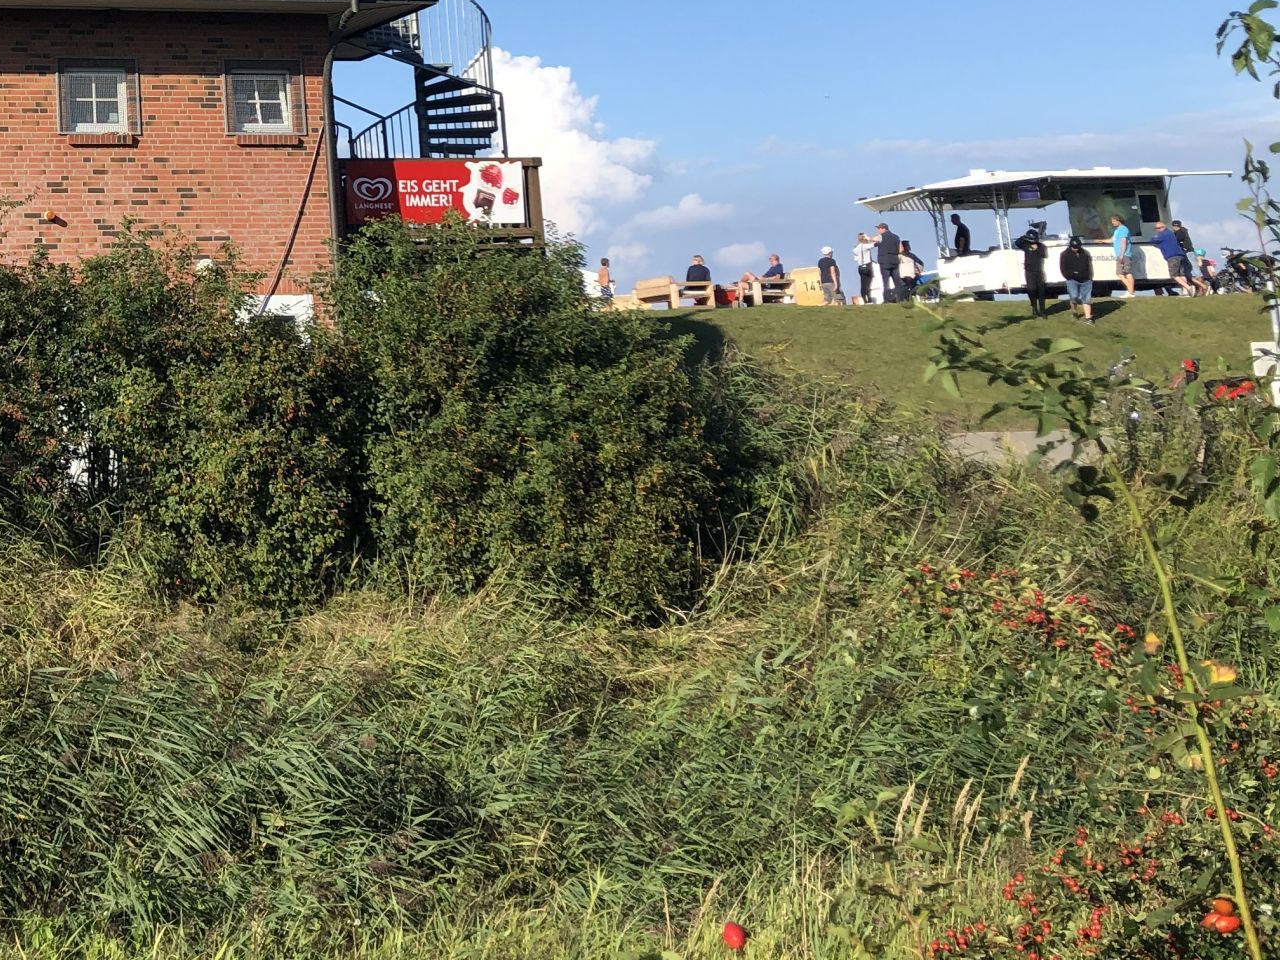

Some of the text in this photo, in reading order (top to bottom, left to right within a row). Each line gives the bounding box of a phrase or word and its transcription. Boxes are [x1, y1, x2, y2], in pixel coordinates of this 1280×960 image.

[398, 179, 459, 192] EIS GEHT
[405, 194, 452, 207] IMMER!
